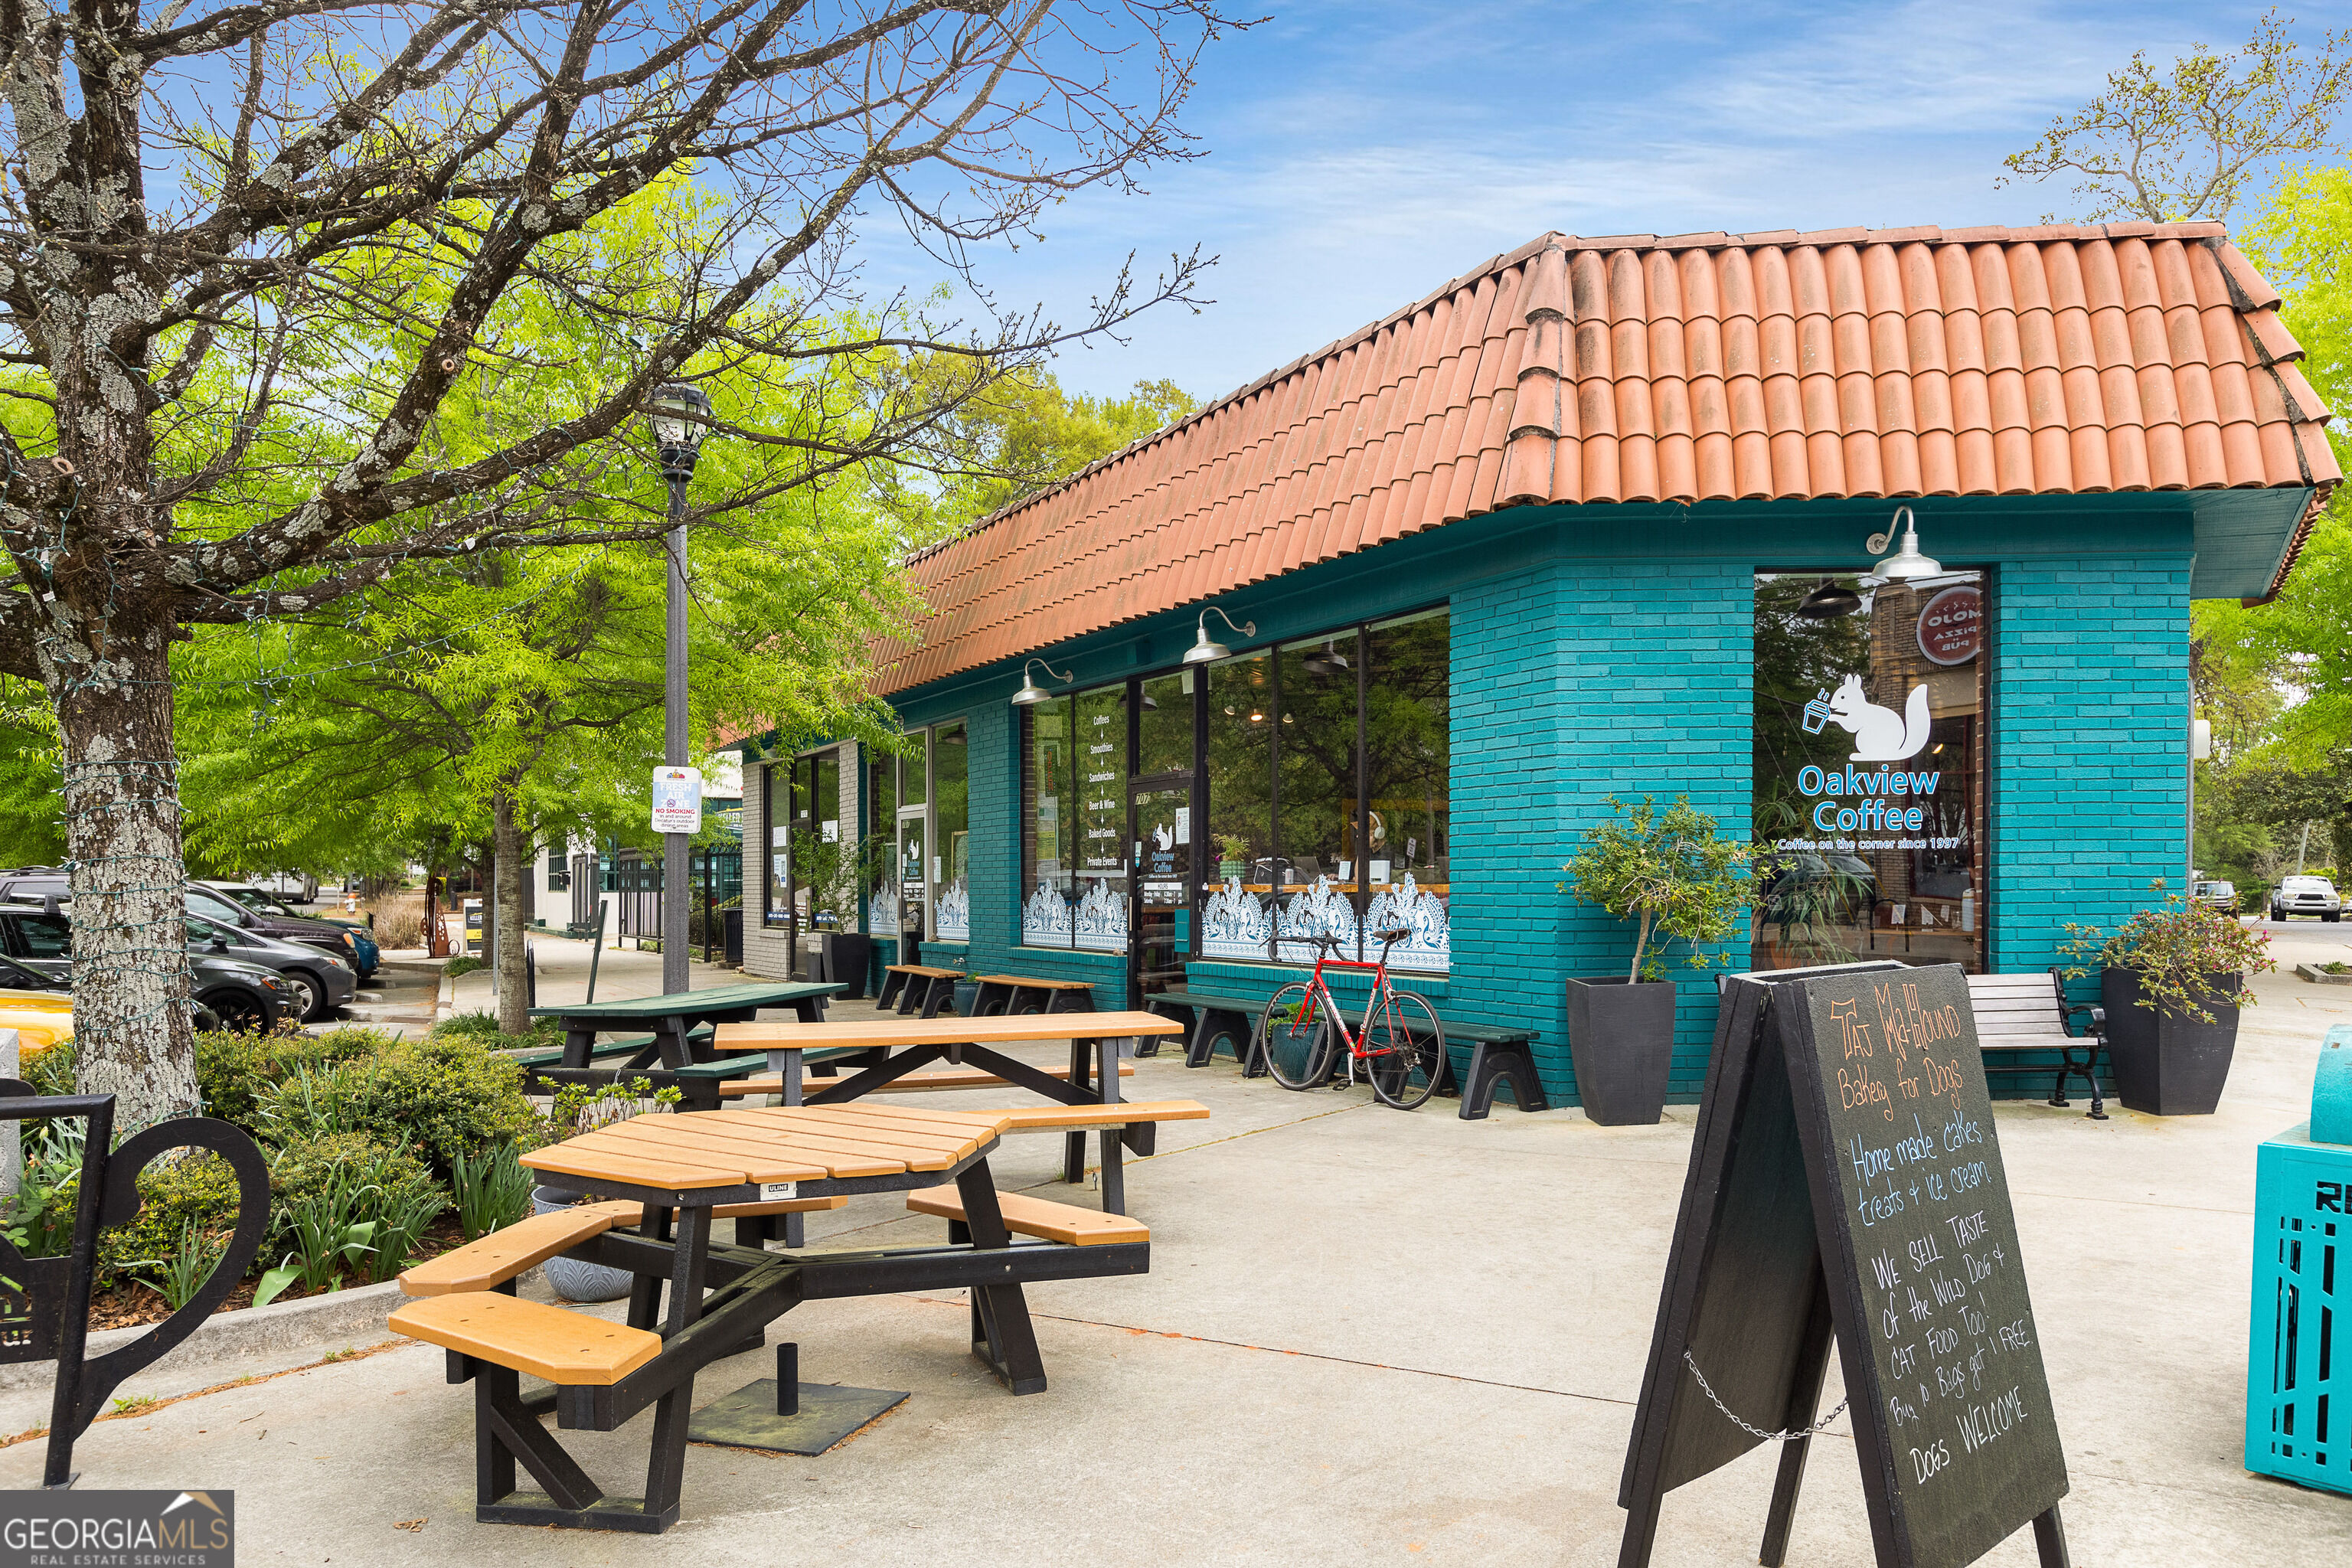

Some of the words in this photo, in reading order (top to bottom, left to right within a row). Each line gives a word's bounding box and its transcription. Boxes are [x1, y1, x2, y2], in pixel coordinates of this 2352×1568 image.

[1093, 714, 1109, 726] Coffees
[1090, 742, 1113, 754] Smoothies
[1089, 770, 1115, 782] Sandwiches
[1798, 763, 1940, 796] Oakview
[660, 782, 692, 792] FRESH
[667, 791, 684, 799] AIR
[1136, 793, 1148, 804] 707
[1089, 801, 1099, 811] Beer
[1104, 799, 1116, 808] Wine
[1813, 799, 1923, 831] Coffee
[1089, 828, 1102, 838] Baked
[1102, 827, 1116, 838] Goods
[1777, 838, 1818, 850] Coffee
[1820, 841, 1834, 850] on
[1837, 838, 1856, 849] the
[1859, 839, 1894, 849] corner
[1897, 838, 1927, 849] since
[1929, 837, 1959, 849] 1997
[1087, 857, 1102, 867] Private
[1102, 856, 1118, 866] Events
[1152, 851, 1174, 862] Oakview
[1154, 862, 1172, 873] Coffee
[1838, 1063, 1893, 1122] Bakery
[1896, 1057, 1919, 1100] for
[1922, 1057, 1963, 1109] Dogs
[1850, 1133, 1895, 1187] Home
[1896, 1112, 1937, 1165] made
[1943, 1109, 1982, 1152] cakes
[1857, 1176, 1904, 1227] treats
[1922, 1167, 1948, 1200] ice
[1909, 1233, 1944, 1272] SELL
[1945, 1210, 1989, 1248] TASTE
[1907, 1286, 1932, 1322] the
[1929, 1269, 1965, 1307] WILD
[1891, 1344, 1916, 1380] CAT
[1926, 1327, 1958, 1359] FOOD
[1890, 1396, 1919, 1432] Buy
[1936, 1361, 1965, 1399] Bags
[1969, 1342, 1984, 1391] get
[1956, 1385, 2028, 1453] WELCOME
